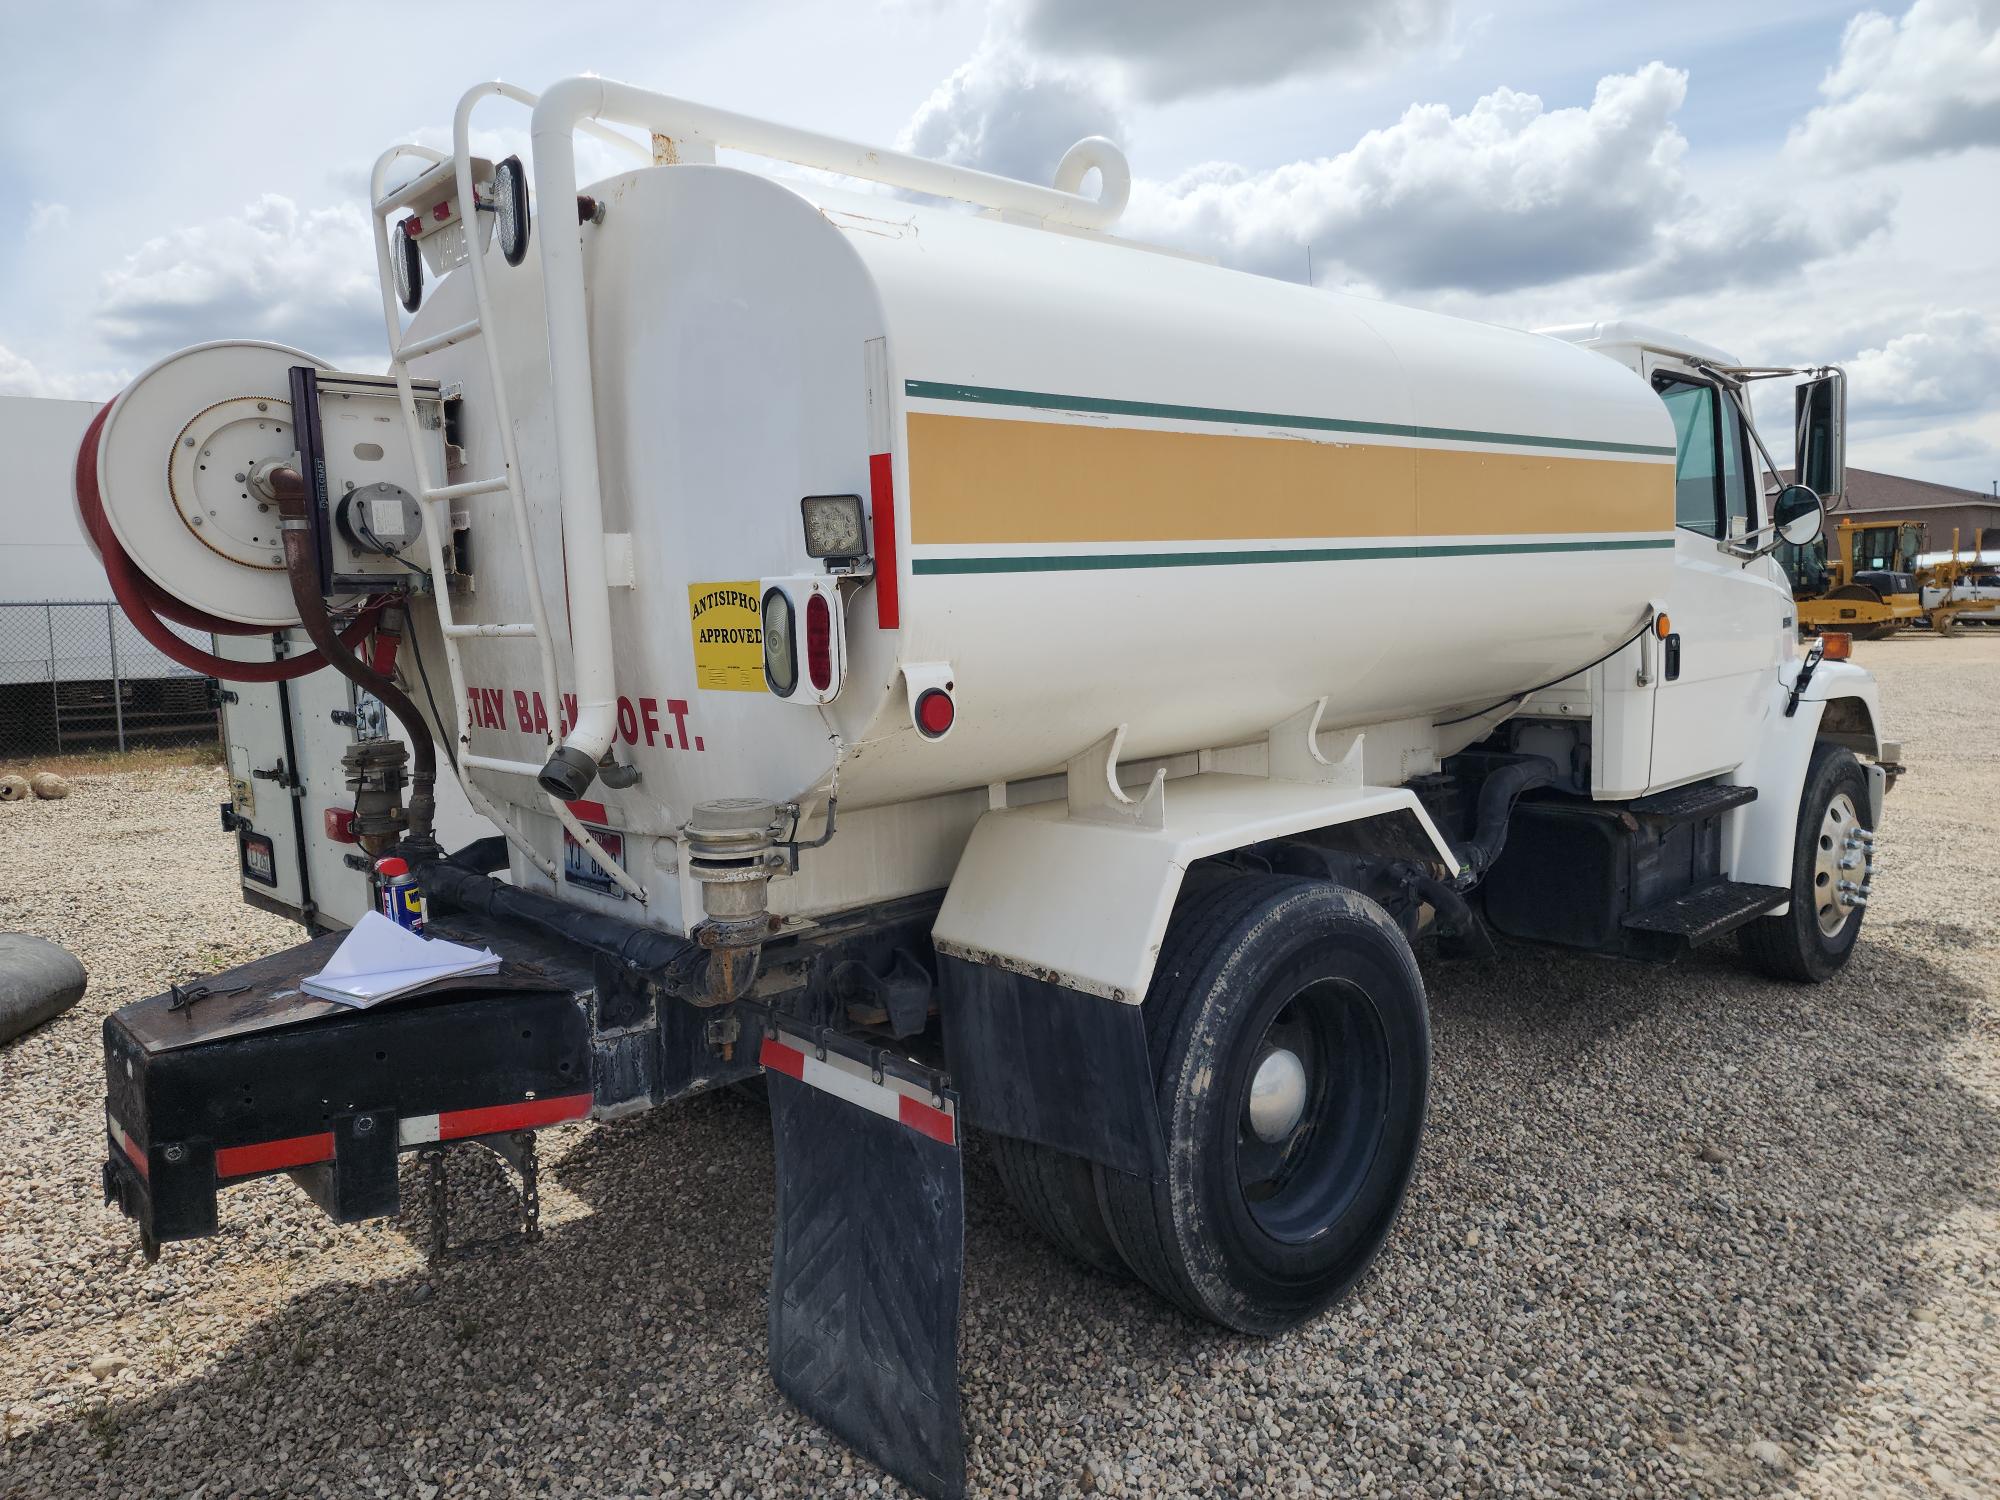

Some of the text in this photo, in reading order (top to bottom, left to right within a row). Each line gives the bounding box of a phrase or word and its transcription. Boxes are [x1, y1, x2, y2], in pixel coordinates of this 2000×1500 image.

[693, 591, 761, 620] ANTISIPHO
[699, 628, 763, 644] APPROVED
[467, 687, 507, 731] TAY
